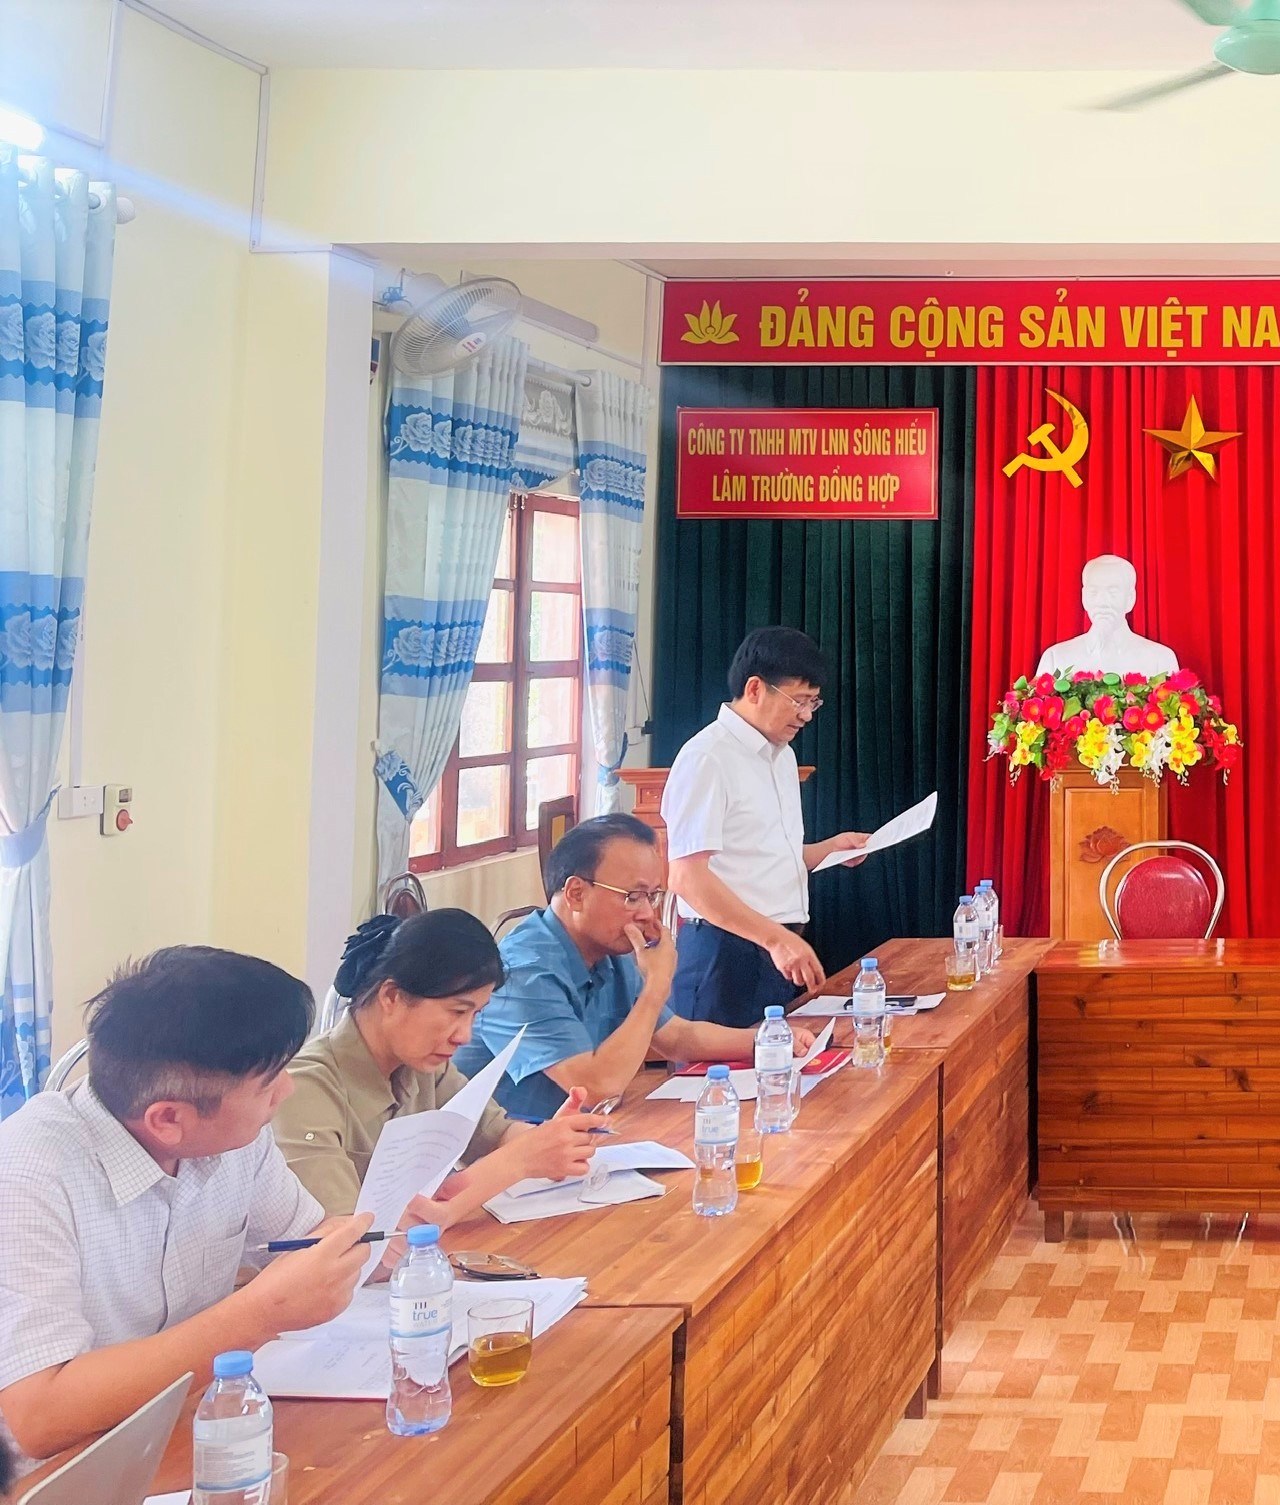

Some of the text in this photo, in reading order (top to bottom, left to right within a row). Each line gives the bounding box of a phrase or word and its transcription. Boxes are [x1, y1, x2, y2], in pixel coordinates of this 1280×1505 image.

[759, 288, 874, 348] ĐẢNG
[889, 297, 1004, 357] CỘNG
[1019, 288, 1106, 348] SẢN
[1119, 297, 1208, 357] VIỆT
[688, 418, 927, 455] CÔNG TY TNHH MTV LNN SÔNG HIẾU
[712, 469, 746, 502] LÂM
[751, 467, 814, 502] TRƯỜNG
[868, 473, 900, 509] HỢP
[412, 1310, 438, 1321] true
